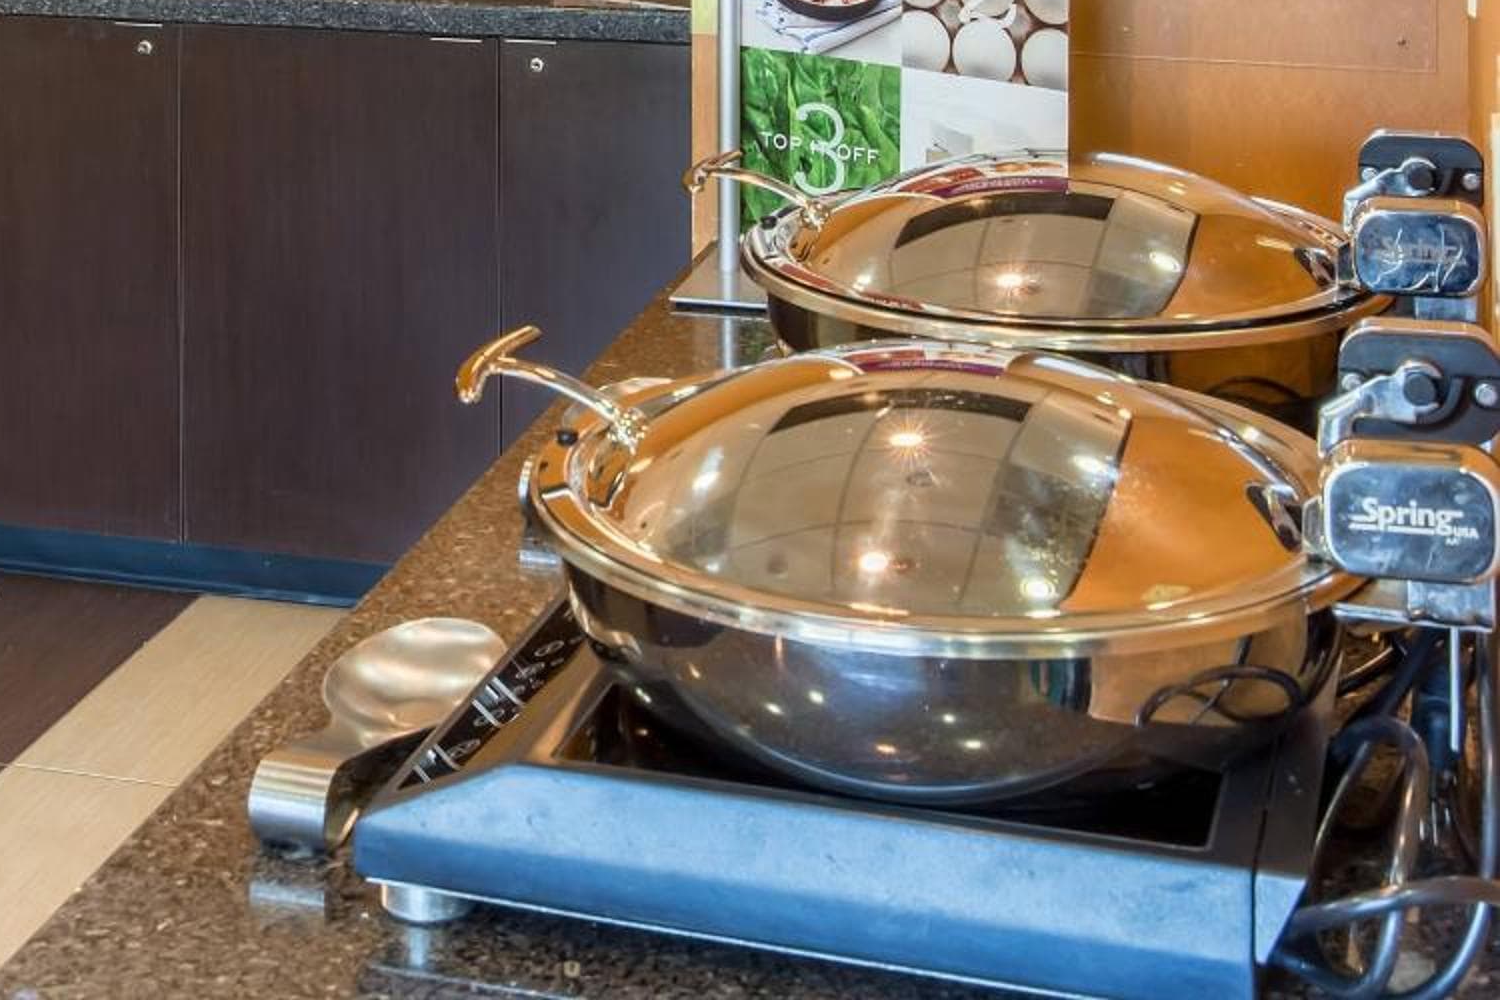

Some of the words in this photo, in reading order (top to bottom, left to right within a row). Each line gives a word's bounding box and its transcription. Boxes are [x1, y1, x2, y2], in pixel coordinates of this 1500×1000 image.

[758, 131, 803, 150] TOP
[837, 143, 879, 165] OFF
[794, 102, 845, 196] 3
[1348, 497, 1463, 535] Spring
